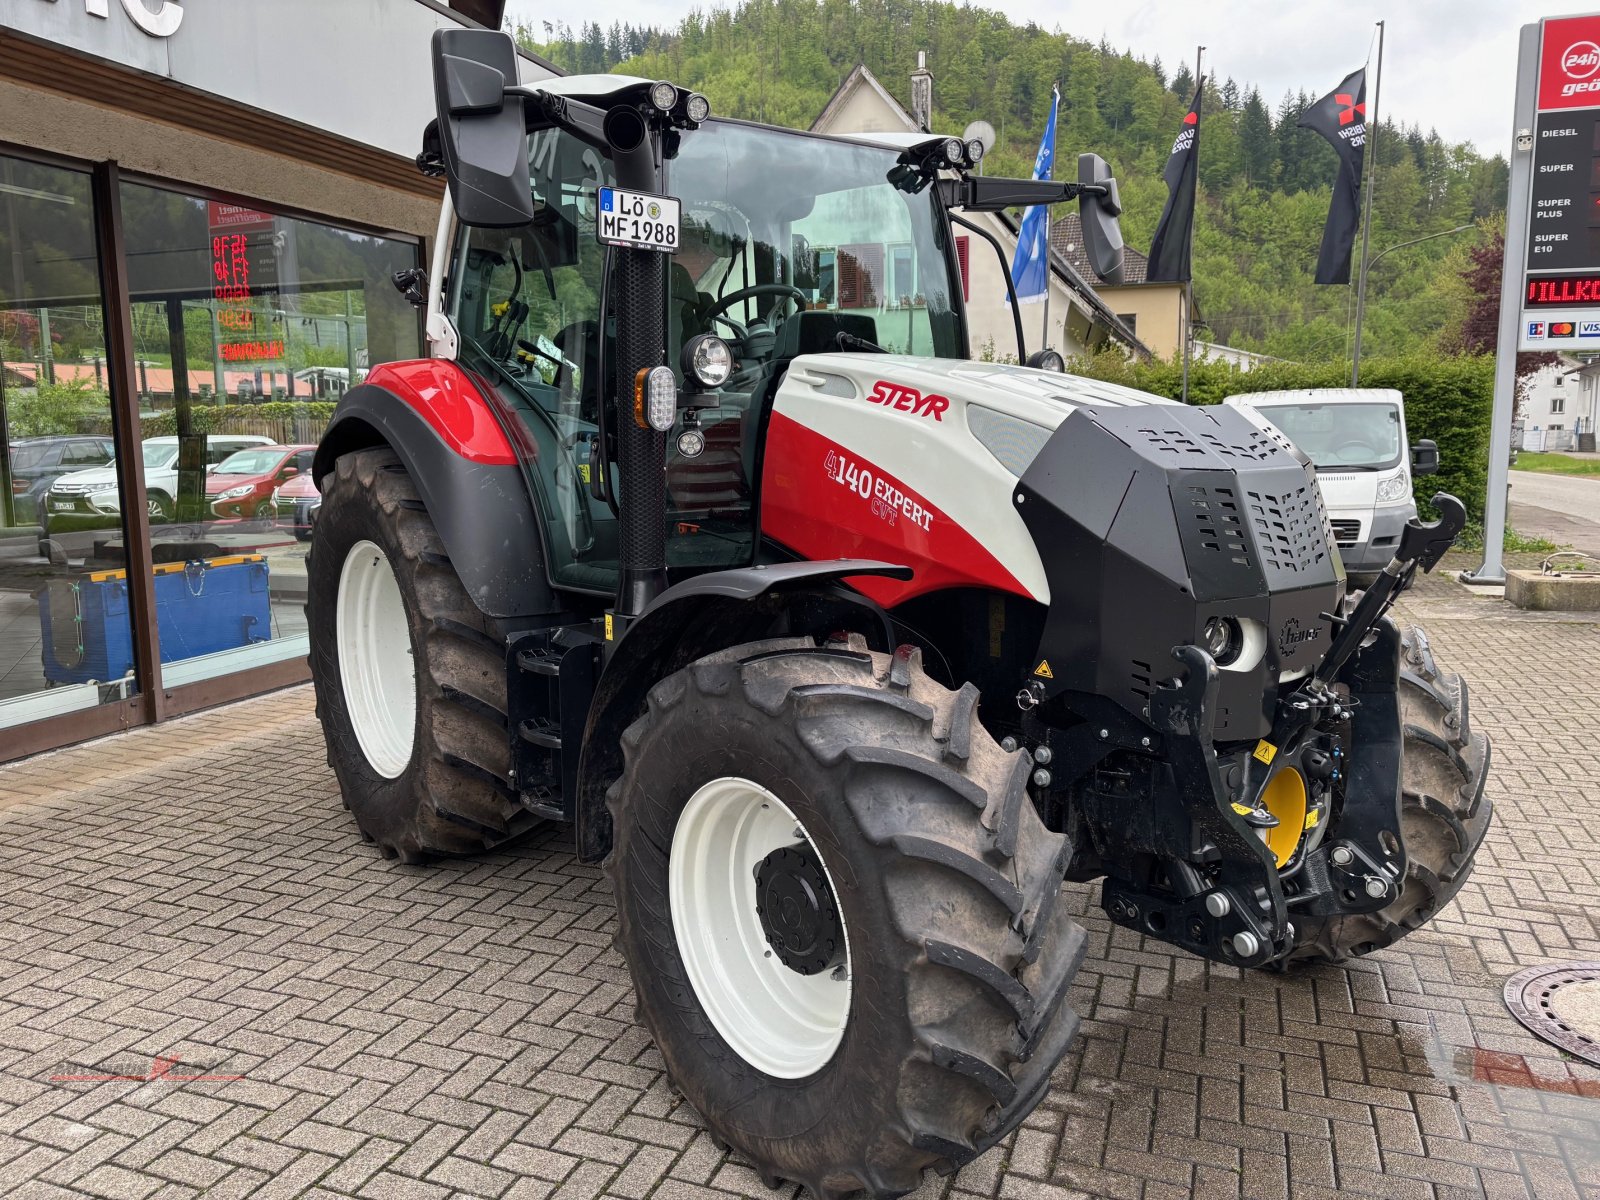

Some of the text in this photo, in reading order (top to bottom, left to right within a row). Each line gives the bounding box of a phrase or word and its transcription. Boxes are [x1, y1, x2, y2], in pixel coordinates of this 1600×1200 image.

[1565, 53, 1598, 67] 24h
[1541, 128, 1578, 138] DIESEL
[1539, 163, 1574, 173] SUPER
[604, 202, 610, 210] D
[620, 194, 644, 217] LÖ
[1537, 198, 1571, 208] SUPER
[1536, 210, 1563, 219] PLUS
[604, 214, 675, 245] MF 1988
[1534, 233, 1569, 242] SUPER
[1534, 246, 1553, 254] E10
[866, 379, 950, 422] STEYR
[823, 449, 934, 532] 4140 EXPERT
[870, 497, 898, 527] CVT
